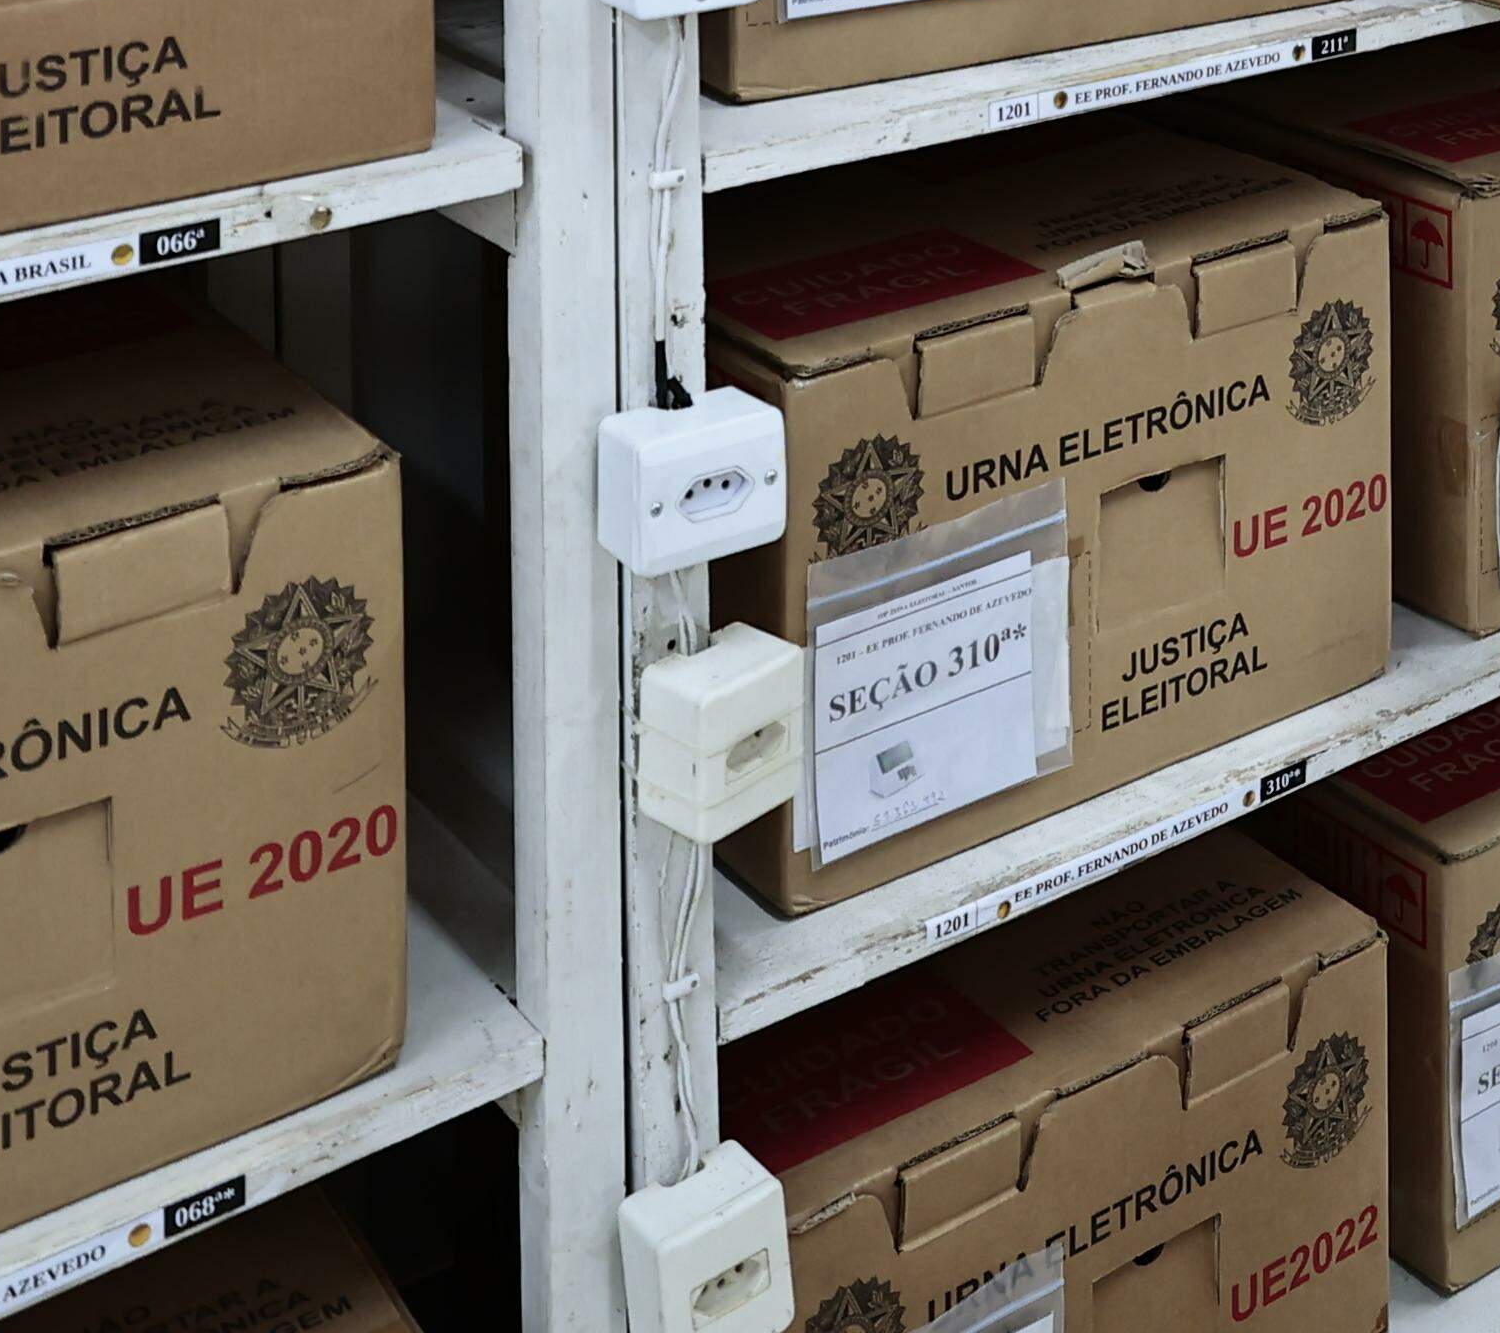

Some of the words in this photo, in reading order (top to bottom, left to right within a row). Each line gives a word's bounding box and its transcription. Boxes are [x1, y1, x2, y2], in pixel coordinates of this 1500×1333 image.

[155, 227, 207, 256] 066ª
[946, 442, 1048, 502] URNA
[1059, 374, 1271, 469] ELETRÔNICA
[1234, 506, 1287, 559] UE
[1301, 474, 1387, 537] 2020
[828, 661, 938, 725] SEÇÃO
[1101, 645, 1268, 733] ELEITORAL
[1122, 611, 1249, 683] JUSTIÇA
[125, 862, 225, 939] UE
[247, 803, 400, 900] 2020
[1014, 888, 1030, 905] EE
[1032, 871, 1076, 899] PROF.
[1078, 839, 1147, 881] FERNANDO
[1150, 829, 1168, 846] DE
[1171, 801, 1228, 839] AZEVEDO
[934, 910, 971, 939] 1201
[1035, 985, 1110, 1023] FORA
[1110, 964, 1150, 987] DA
[1150, 888, 1301, 966] EMBALAGEM
[1046, 1130, 1262, 1271] ELETRÔNICA
[1232, 1206, 1378, 1324] UE2022
